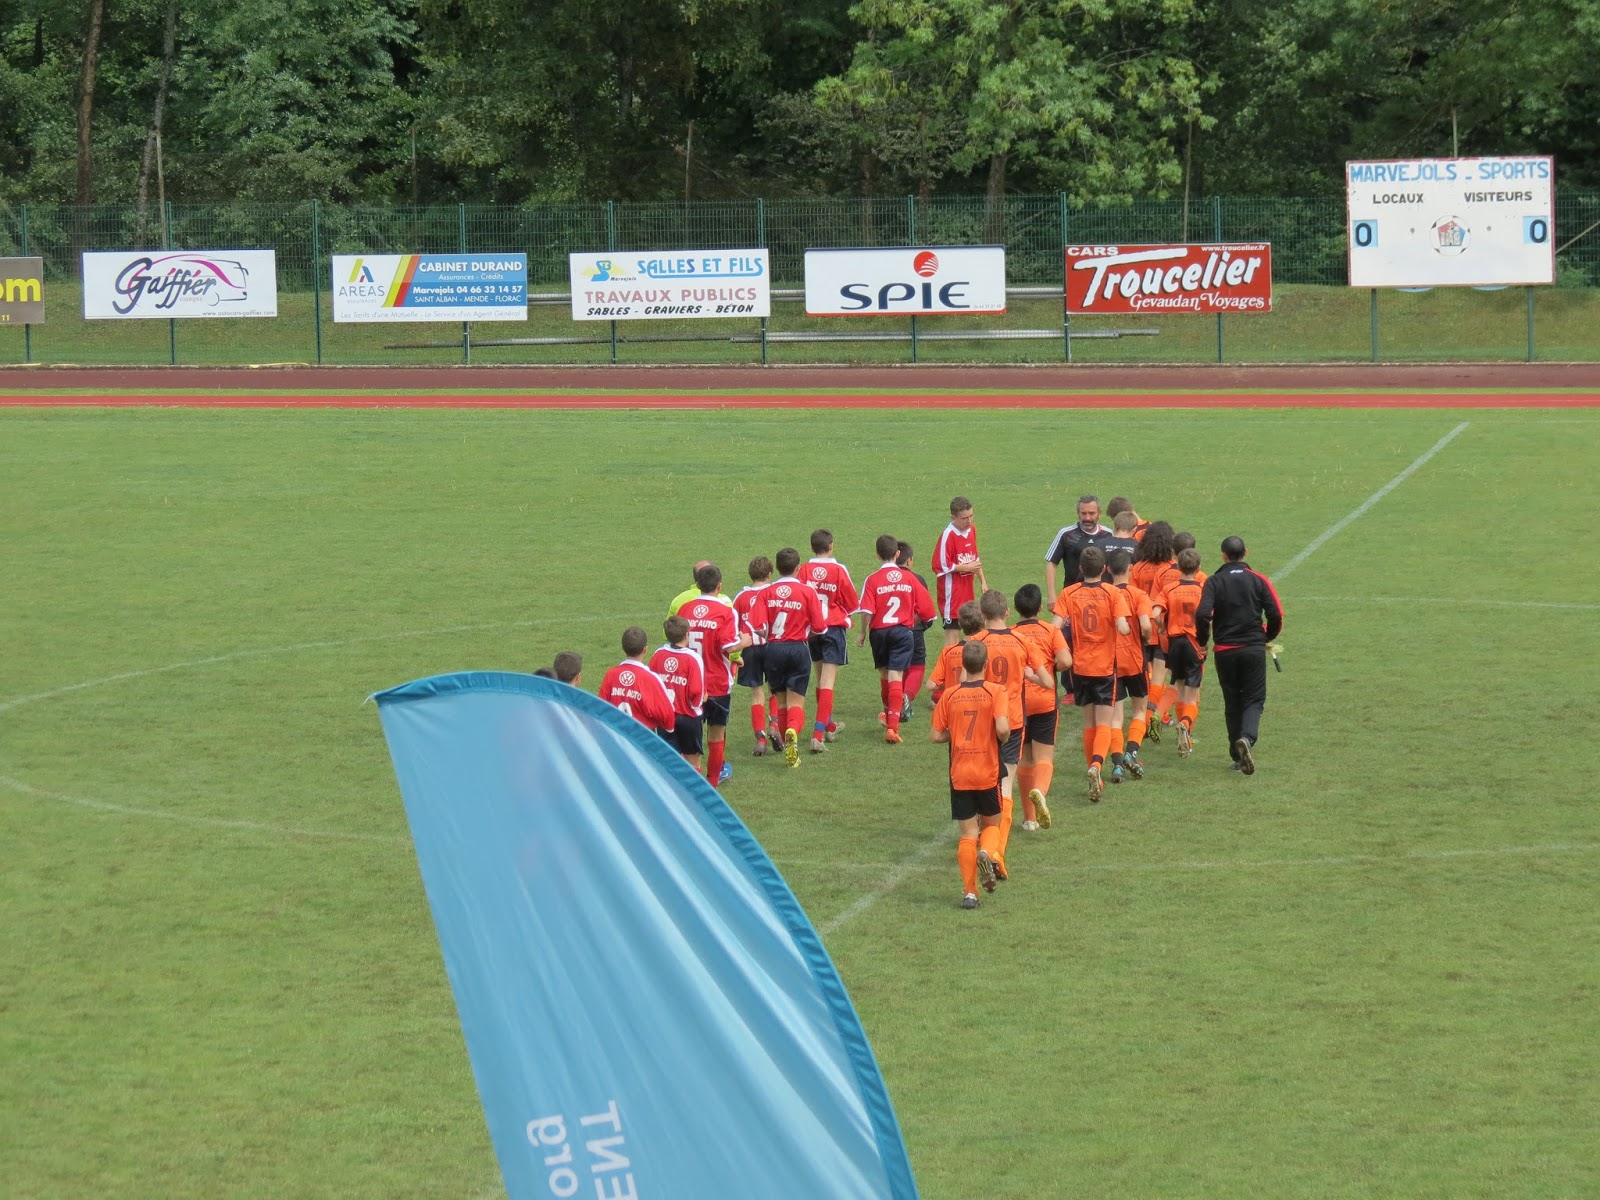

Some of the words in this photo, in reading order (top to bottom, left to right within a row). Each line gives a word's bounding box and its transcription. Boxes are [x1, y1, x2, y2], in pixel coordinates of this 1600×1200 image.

[1350, 163, 1458, 182] MARVEJOLS
[1478, 161, 1550, 180] SPORTS
[1372, 193, 1424, 204] LOCAUX
[1464, 191, 1533, 203] VISITEURS
[1355, 222, 1372, 247] 0
[1530, 219, 1548, 244] 0
[1067, 247, 1119, 256] CARS
[418, 262, 468, 272] CABINET
[471, 261, 522, 272] DURAND
[638, 258, 696, 274] SALLES
[702, 258, 722, 272] ET
[729, 257, 763, 276] FILS
[112, 257, 216, 314] Gaiffier
[1074, 248, 1261, 308] Troucelier
[0, 278, 41, 302] m
[338, 286, 385, 297] AREAS
[412, 286, 454, 295] Marvejols
[584, 290, 672, 304] TRAVAUX
[681, 288, 757, 301] PUBLICS
[840, 282, 970, 310] SPIE
[586, 306, 630, 316] SABLES
[644, 305, 702, 315] GRAVIERS
[715, 304, 754, 313] BÉTON
[1130, 294, 1200, 312] Gevaudan
[1200, 292, 1264, 309] Voyages
[820, 582, 837, 592] AUTO
[876, 584, 895, 594] CLINIC
[896, 584, 912, 593] AUTO
[784, 601, 802, 610] AUTO
[882, 596, 901, 624] 2
[698, 620, 717, 629] AUTO
[772, 611, 788, 639] 4
[1082, 604, 1097, 632] 6
[689, 631, 704, 658] 5
[992, 656, 1008, 684] 9
[964, 710, 978, 741] 7
